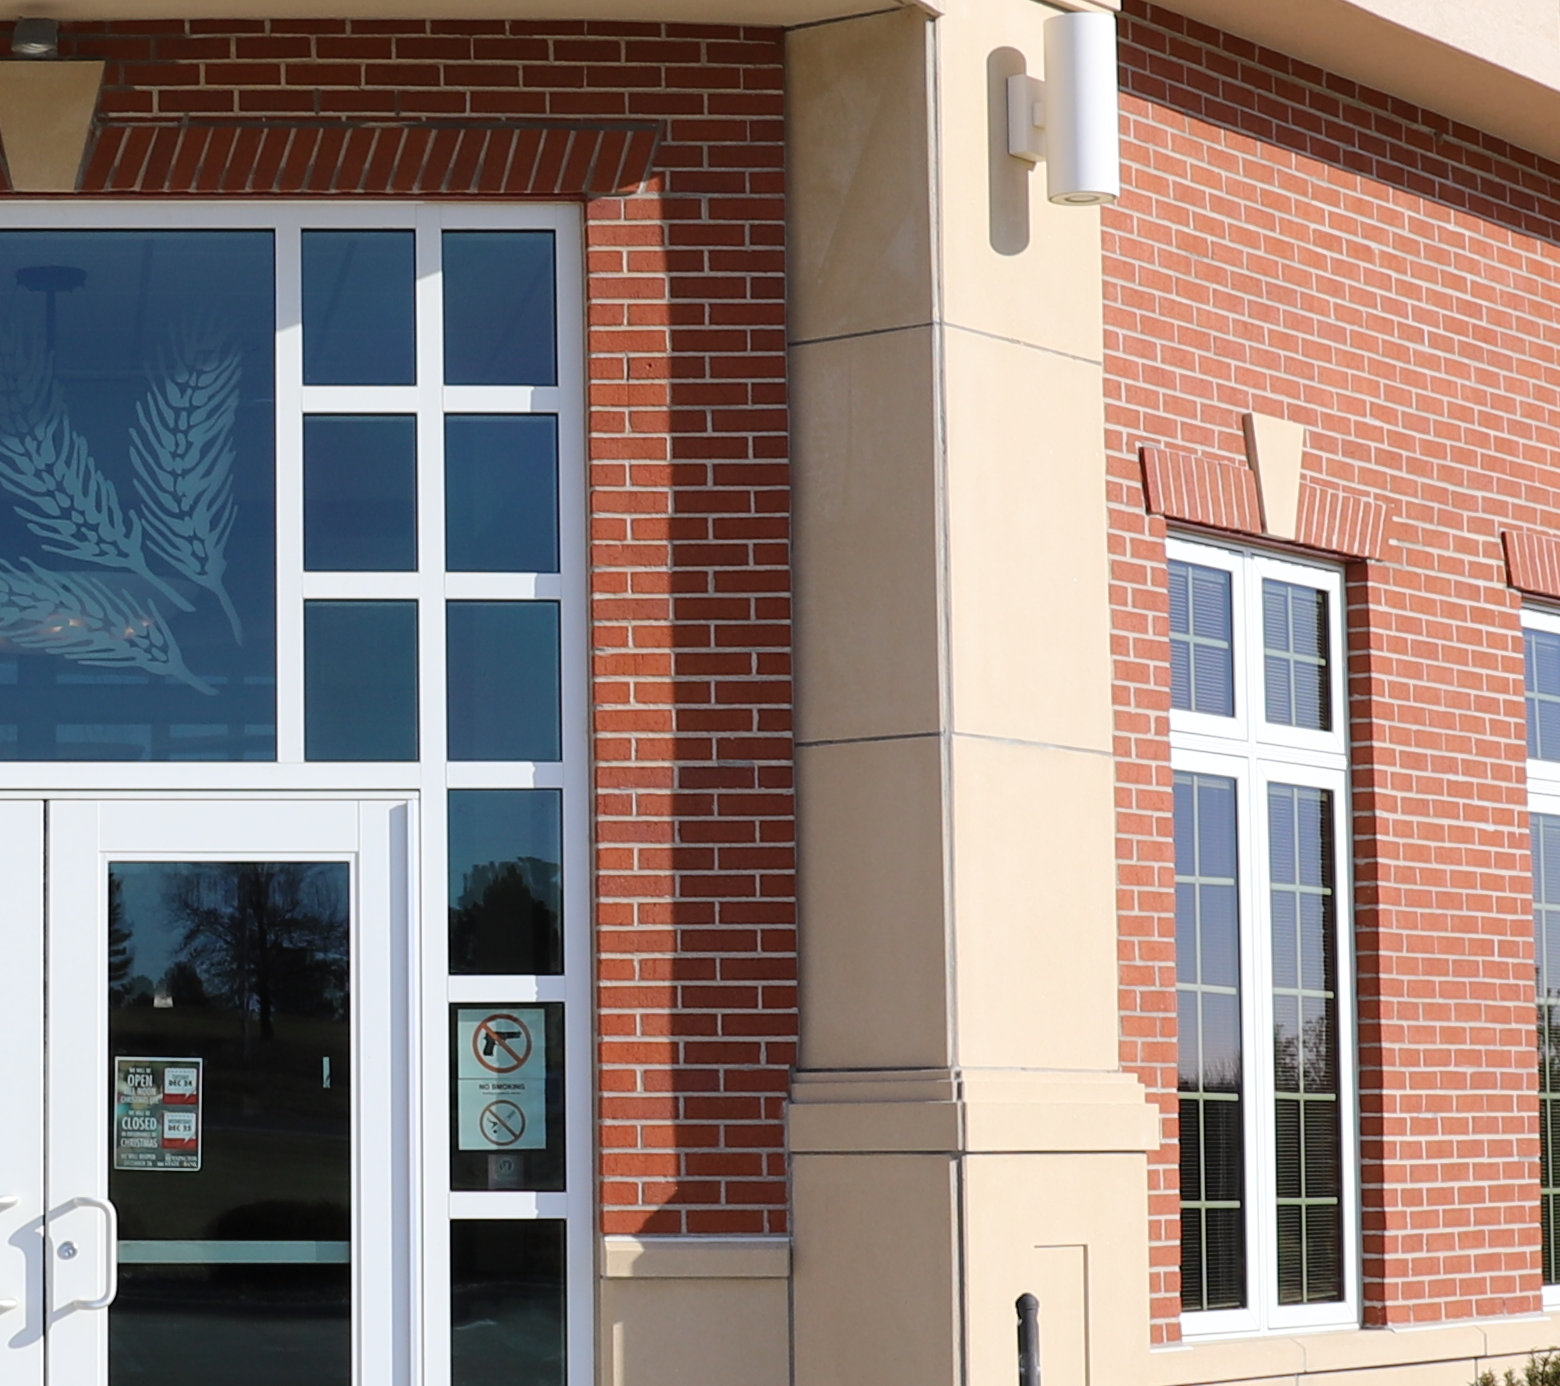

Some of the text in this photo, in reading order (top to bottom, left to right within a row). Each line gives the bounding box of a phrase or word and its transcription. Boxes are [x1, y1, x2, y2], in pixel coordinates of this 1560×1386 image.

[127, 1074, 153, 1087] OPEN
[168, 1079, 181, 1087] DEC
[121, 1116, 157, 1130] CLOSED
[168, 1124, 181, 1132] DEC
[120, 1137, 158, 1148] CHRISTMAS
